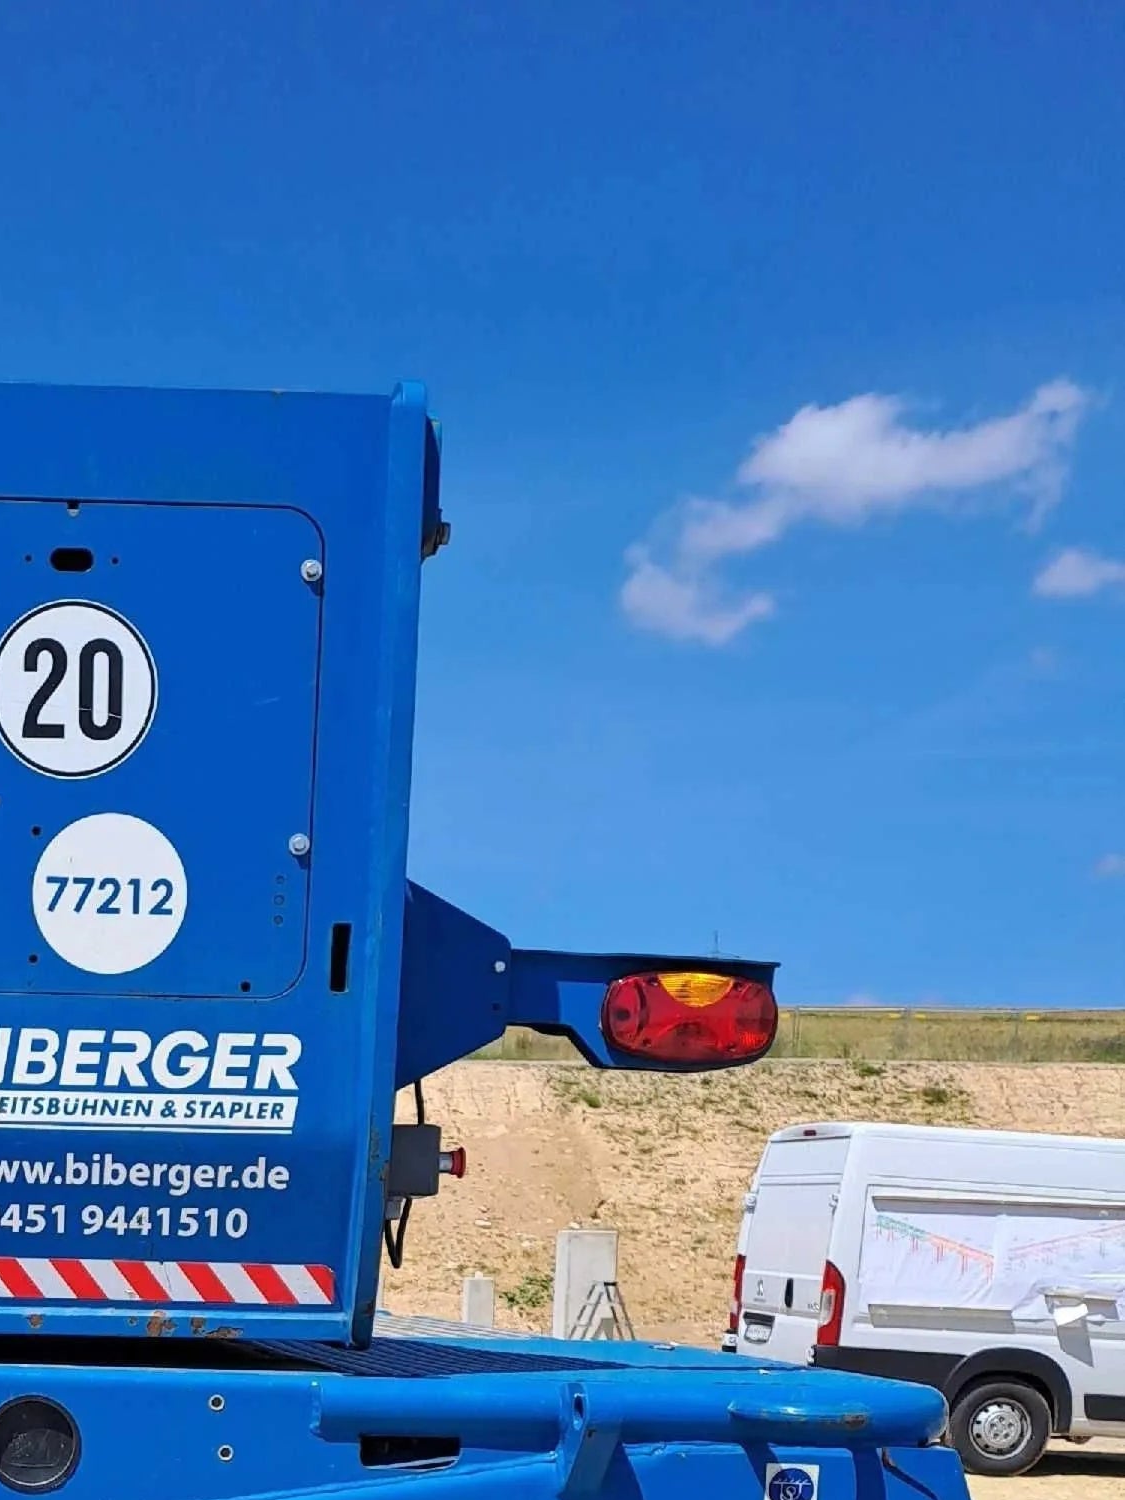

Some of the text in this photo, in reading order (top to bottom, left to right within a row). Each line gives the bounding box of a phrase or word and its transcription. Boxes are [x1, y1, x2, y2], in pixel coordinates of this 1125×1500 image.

[22, 637, 123, 741] 20
[46, 876, 174, 916] 77212
[160, 1100, 177, 1118] &
[184, 1099, 284, 1120] STAPLER
[81, 1205, 248, 1239] 9441510
